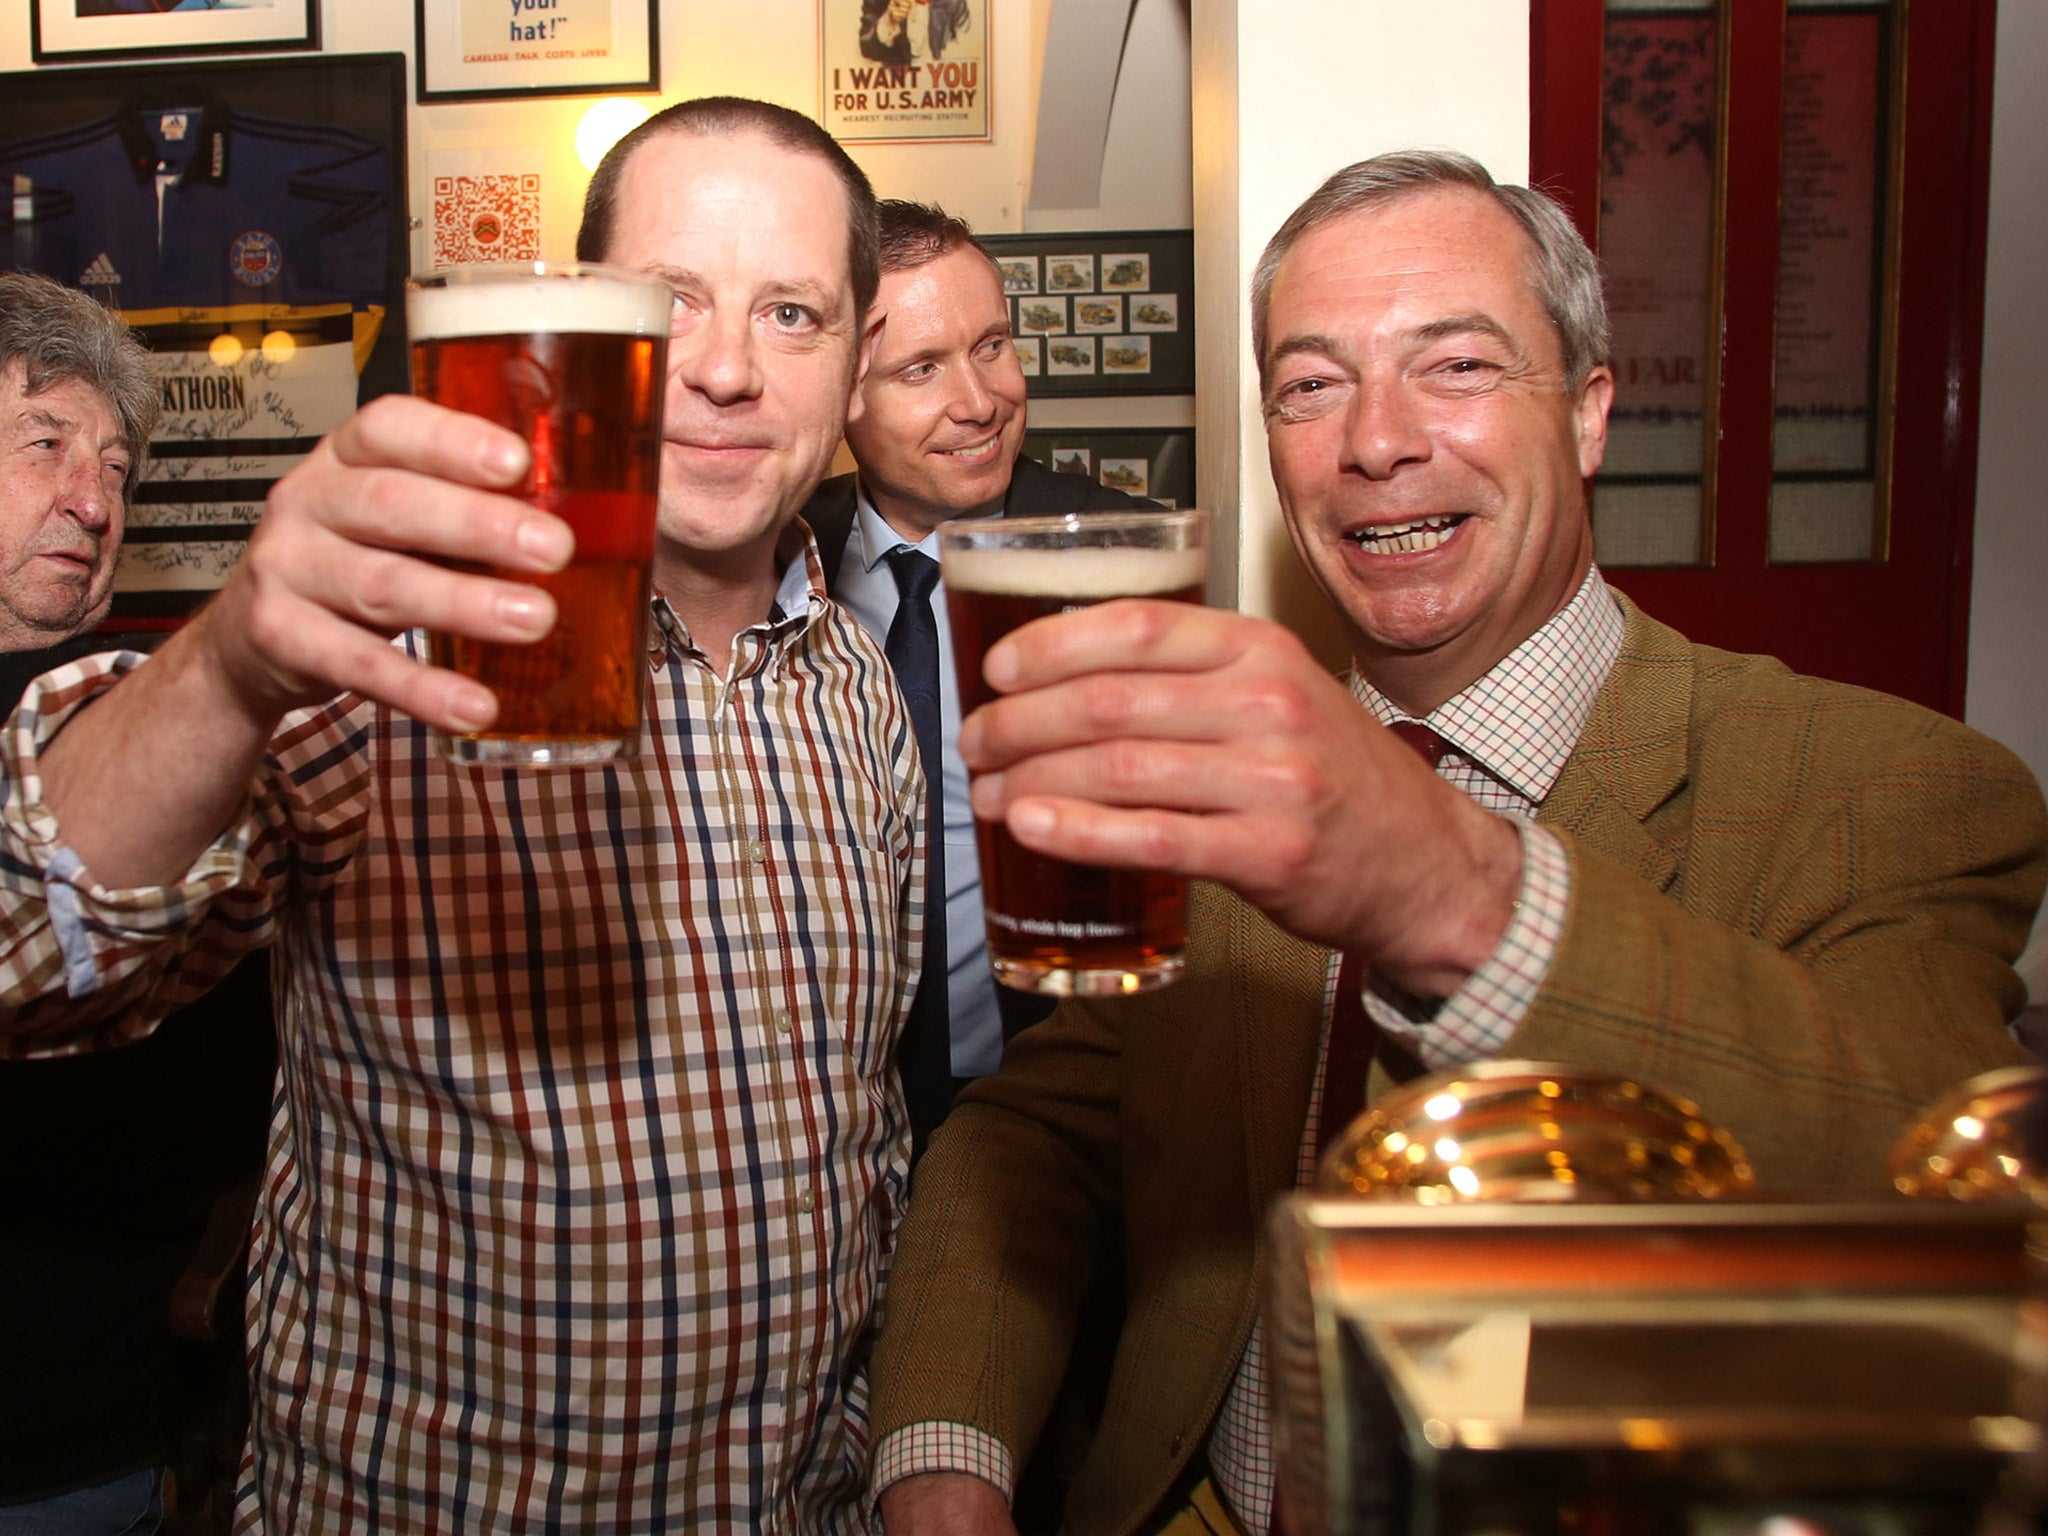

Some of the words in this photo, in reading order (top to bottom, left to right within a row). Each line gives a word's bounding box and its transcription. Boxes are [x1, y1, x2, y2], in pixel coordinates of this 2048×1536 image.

[463, 53, 509, 63] CARELESS
[515, 51, 539, 60] TALK
[545, 50, 575, 59] COSTS
[581, 48, 608, 57] LIVES
[833, 68, 841, 90] I
[849, 66, 921, 90] WANT
[926, 62, 978, 88] YOU
[834, 93, 868, 111] FOR
[921, 89, 977, 109] ARMY
[842, 114, 880, 122] NEAREST
[884, 112, 934, 121] RECRUITING
[936, 110, 969, 120] STATION
[79, 272, 121, 286] adidas
[162, 374, 246, 415] KTHORN
